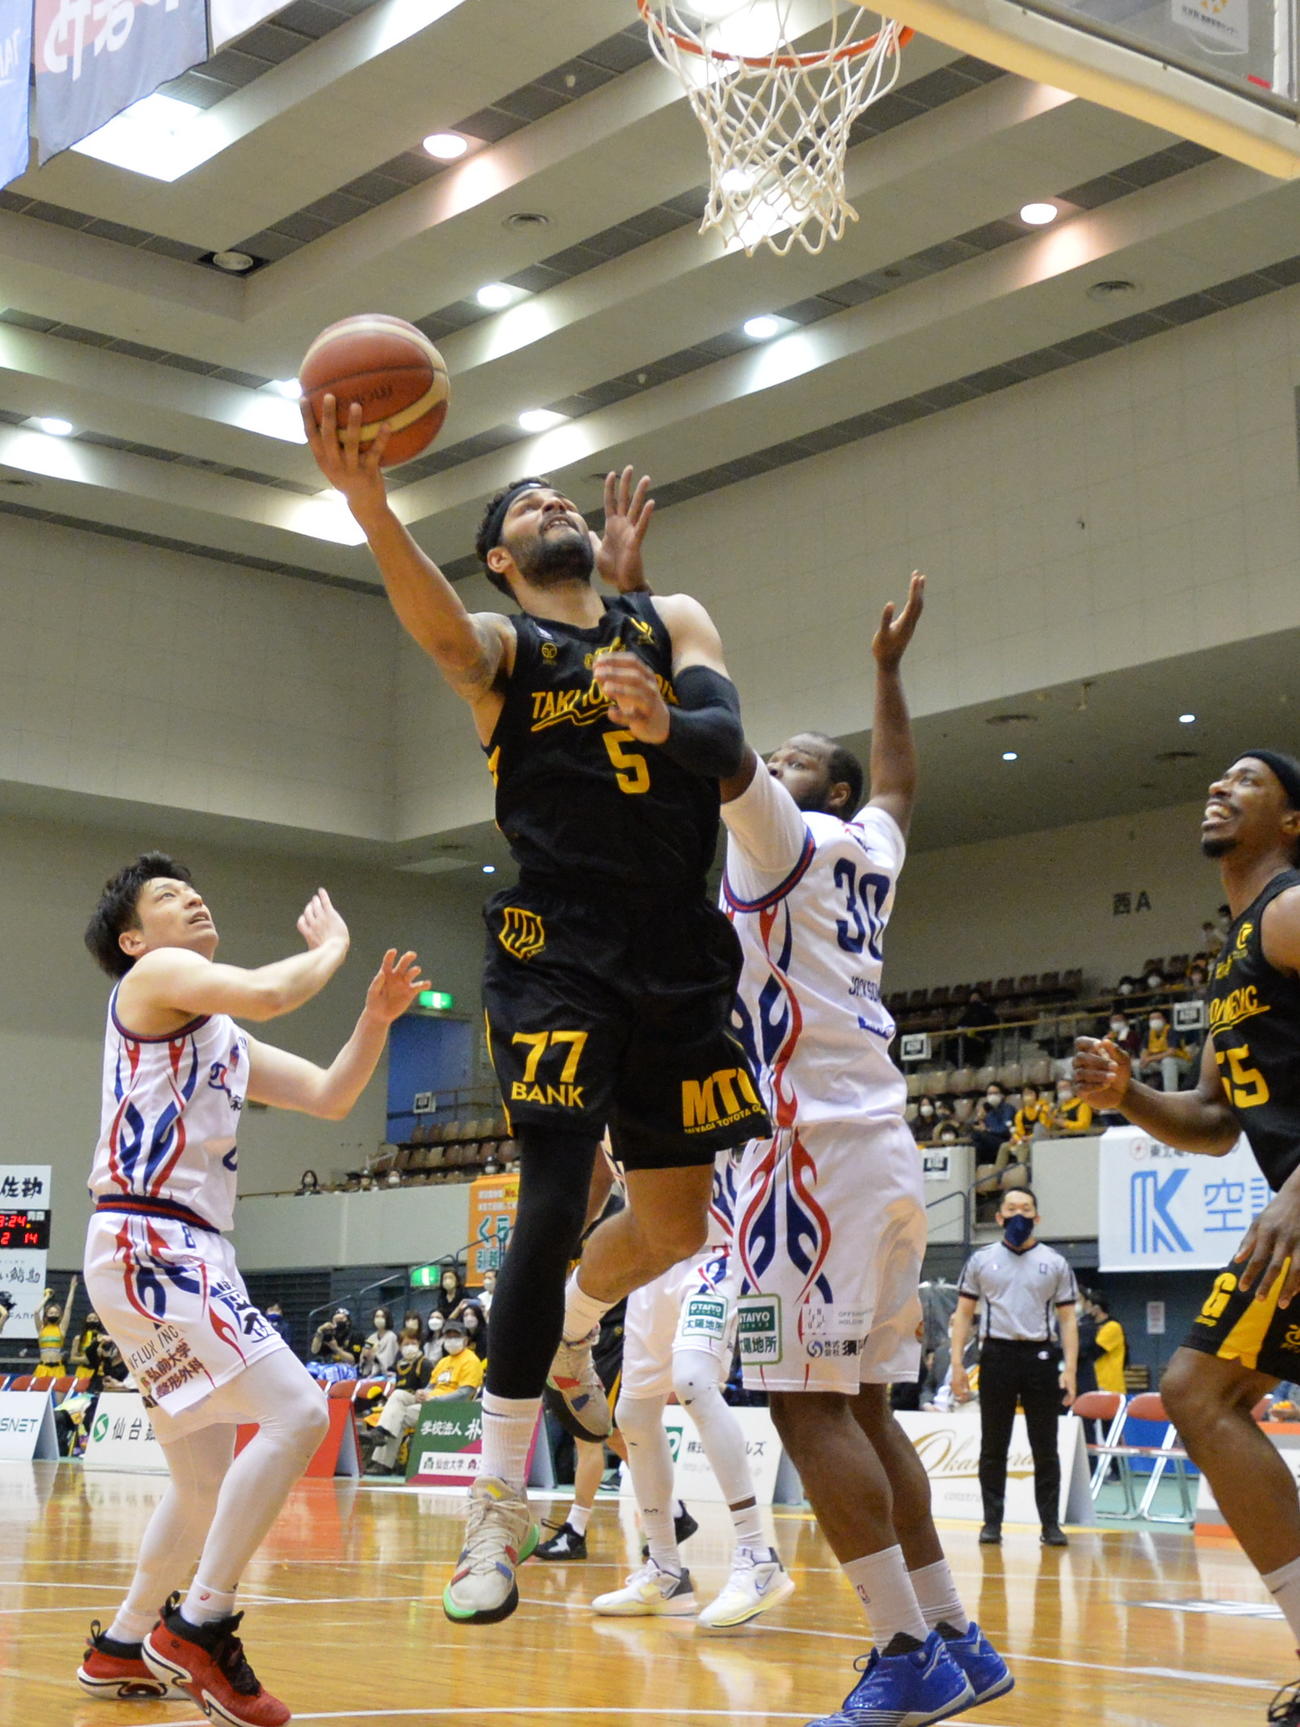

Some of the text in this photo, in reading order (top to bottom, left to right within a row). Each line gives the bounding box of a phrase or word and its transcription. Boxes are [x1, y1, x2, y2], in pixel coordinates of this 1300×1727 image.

[601, 730, 651, 795] 5
[833, 857, 890, 961] 30
[511, 1030, 589, 1083] 77
[511, 1081, 585, 1109] BANK
[716, 1108, 751, 1128] TOYOTA
[742, 1312, 770, 1322] TAIYO
